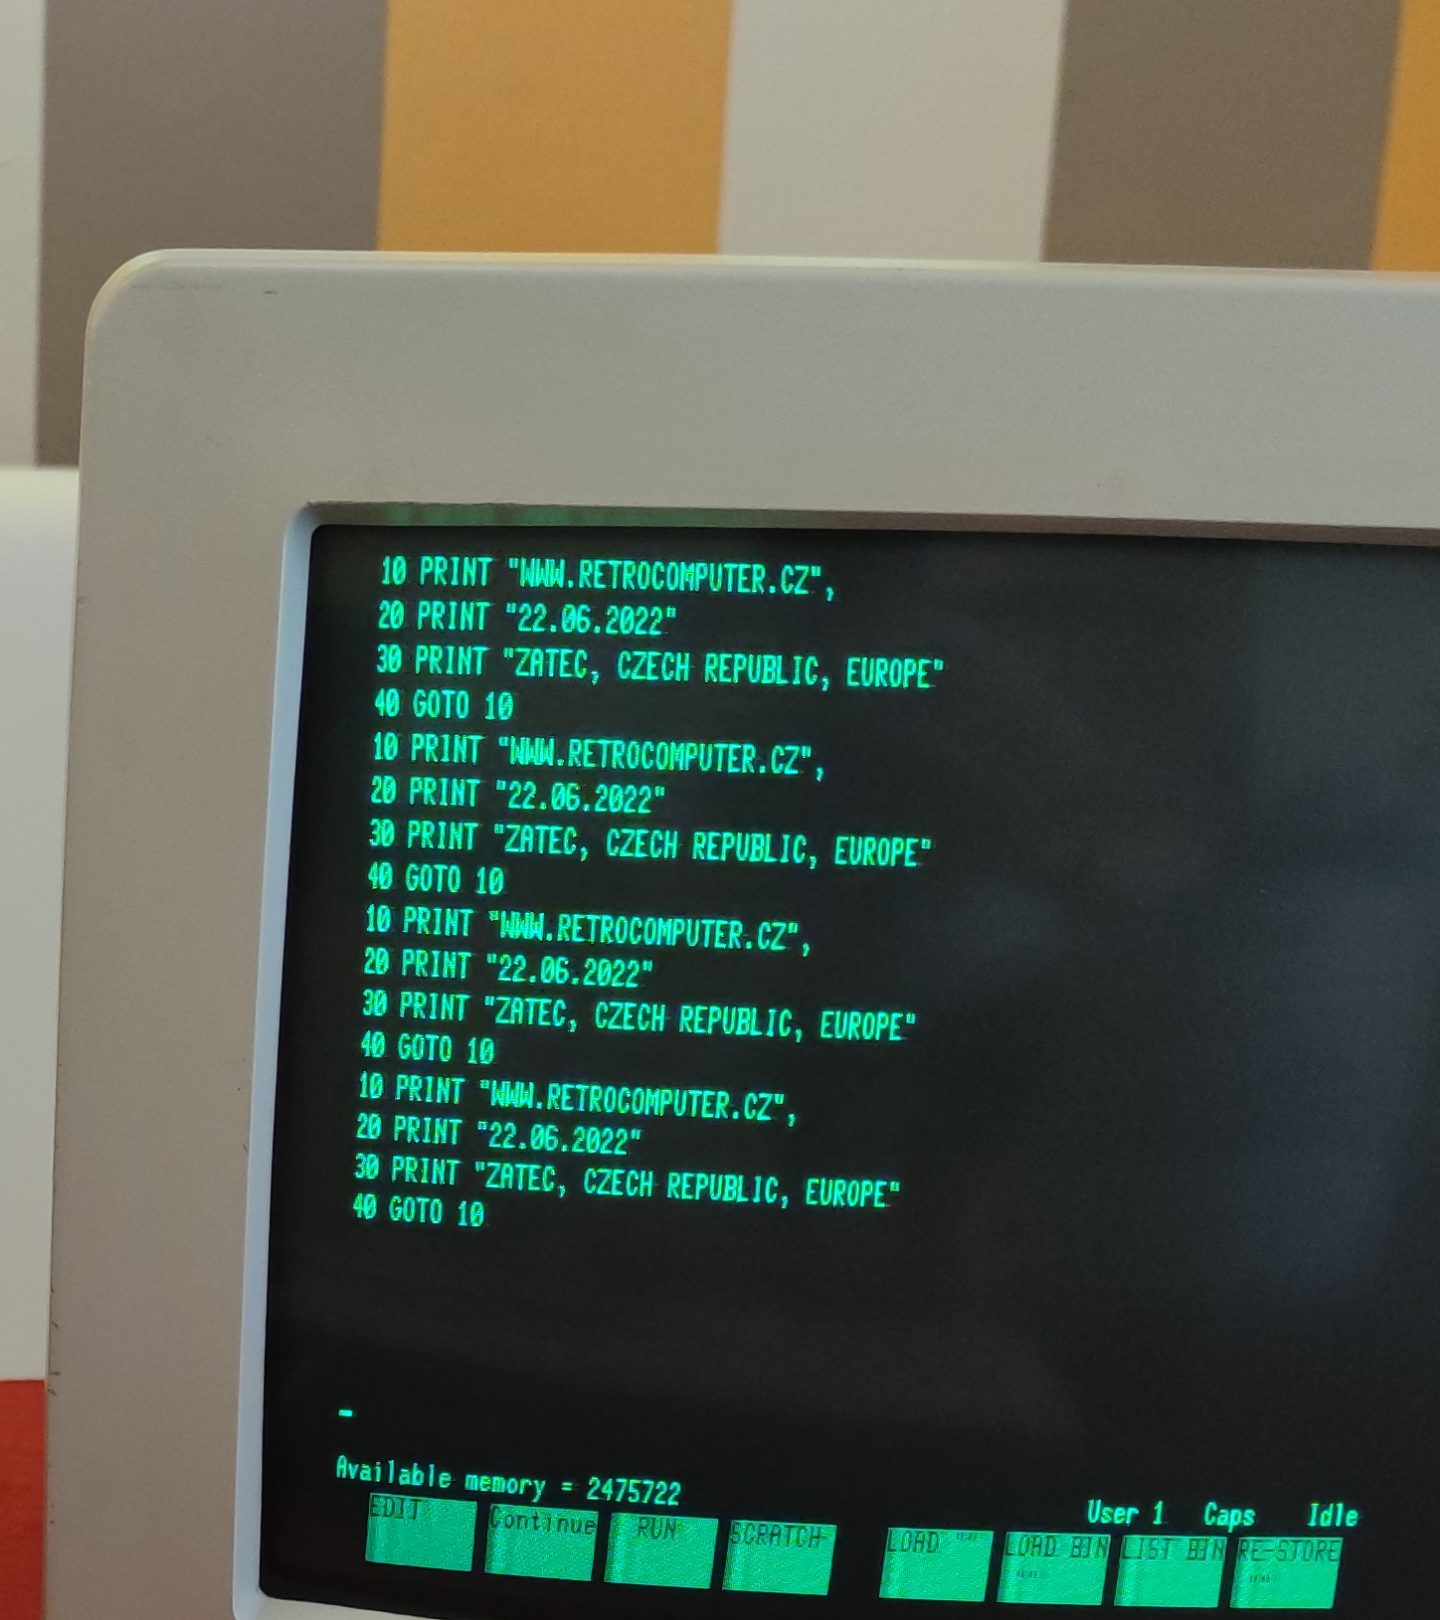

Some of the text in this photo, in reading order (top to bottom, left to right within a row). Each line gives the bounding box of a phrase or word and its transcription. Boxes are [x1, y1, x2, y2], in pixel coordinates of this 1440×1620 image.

[382, 555, 834, 601] 10 PRINT "WWW.RETROCOMPUTER.CZ",
[378, 599, 676, 637] 20 PRINT "22.06.2022"
[376, 643, 944, 691] 30 PRINT "ZATEC, CZECH REPUBLIC, EUROPE"
[374, 688, 515, 721] 40 GOTO 10
[374, 731, 824, 782] 10 PRINT "WWW.RETROCOMPUTER.CZ",
[371, 774, 665, 815] 20 PRINT "22.06.2022"
[369, 818, 931, 870] 30 PRINT "ZATEC, CZECH REPUBLIC, EUROPE"
[368, 861, 505, 896] 40 GOTO 10
[367, 904, 810, 957] 10 PRINT "WWW.RETROCOMPUTER.CZ",
[364, 946, 653, 988] 20 PRINT "22.06.2022"
[362, 988, 916, 1043] 30 PRINT "ZATEC, CZECH REPUBLIC, EUROPE"
[360, 1030, 495, 1065] 40 GOTO 10
[360, 1071, 796, 1127] 10 PRINT "WWW.RETROCOMPUTER.CZ",
[356, 1112, 642, 1155] 20 PRINT "22.06.2022"
[353, 1152, 900, 1209] 30 PRINT "ZATEC, CZECH REPUBLIC, EUROPE"
[353, 1193, 484, 1227] 40 GOTO 10
[335, 1454, 452, 1489] Available
[465, 1472, 546, 1503] memory
[586, 1475, 682, 1507] 2475722
[369, 1496, 421, 1520] EDIT
[489, 1506, 596, 1537] Continue
[1087, 1498, 1164, 1527] User 1
[1204, 1500, 1257, 1534] Caps
[1307, 1502, 1359, 1528] Idle
[637, 1517, 677, 1542] RUN
[887, 1529, 940, 1553] LOAD
[1004, 1533, 1109, 1560] LOAD BIN
[1122, 1535, 1227, 1562] LIST BIN
[1239, 1537, 1342, 1563] RE-STORE
